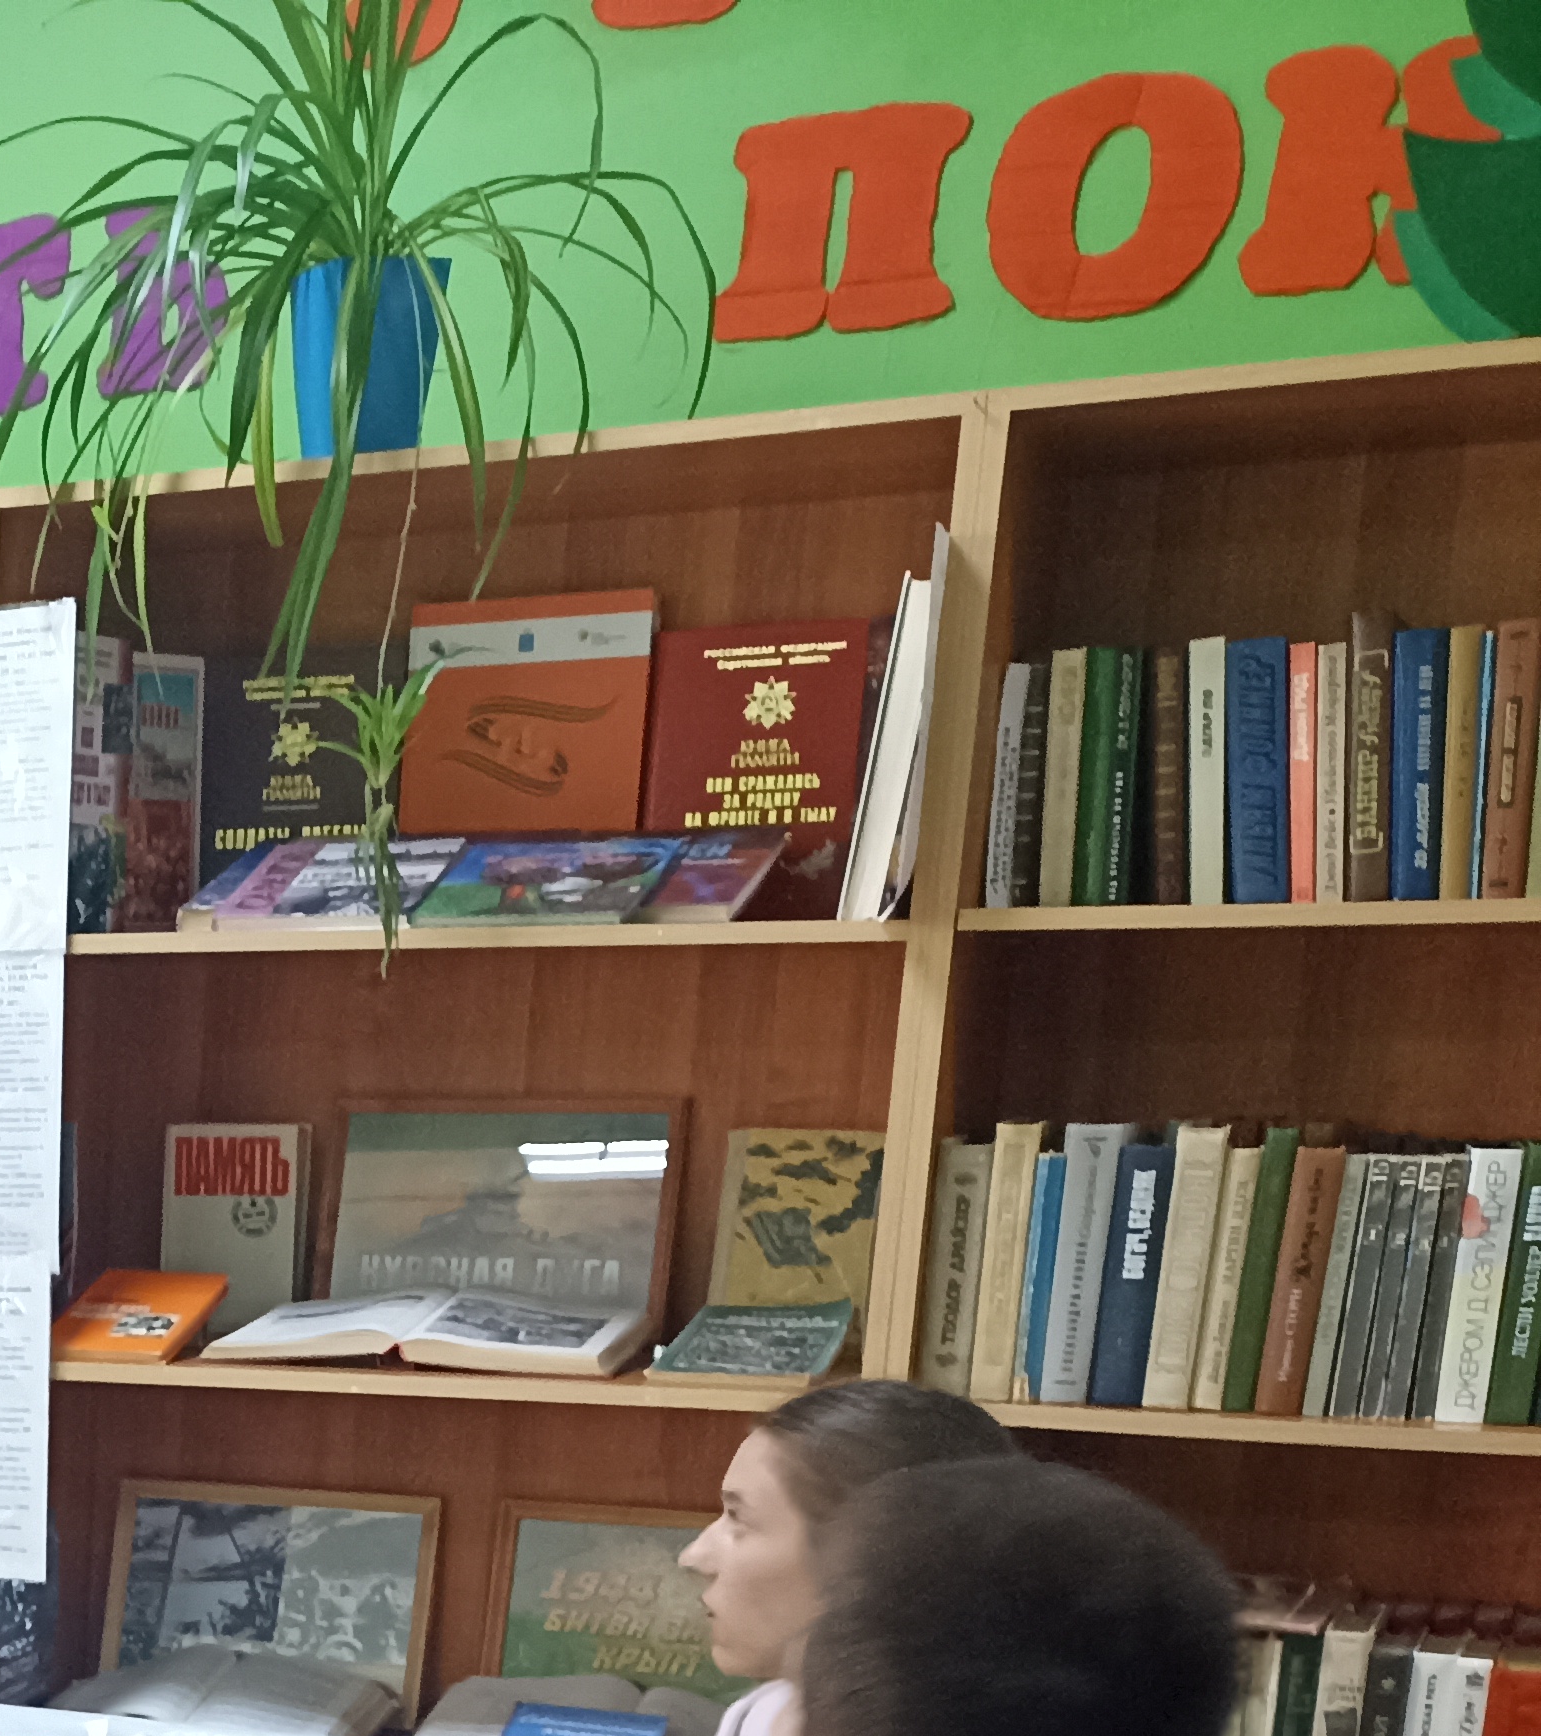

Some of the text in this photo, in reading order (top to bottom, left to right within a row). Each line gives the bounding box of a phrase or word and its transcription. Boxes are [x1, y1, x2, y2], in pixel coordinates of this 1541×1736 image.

[174, 1136, 290, 1197] ПАМЯТЬ
[359, 1254, 515, 1290] КУРСКАЯ
[1454, 1318, 1486, 1411] ДЖЕРОМ
[543, 1608, 656, 1639] БИТВА
